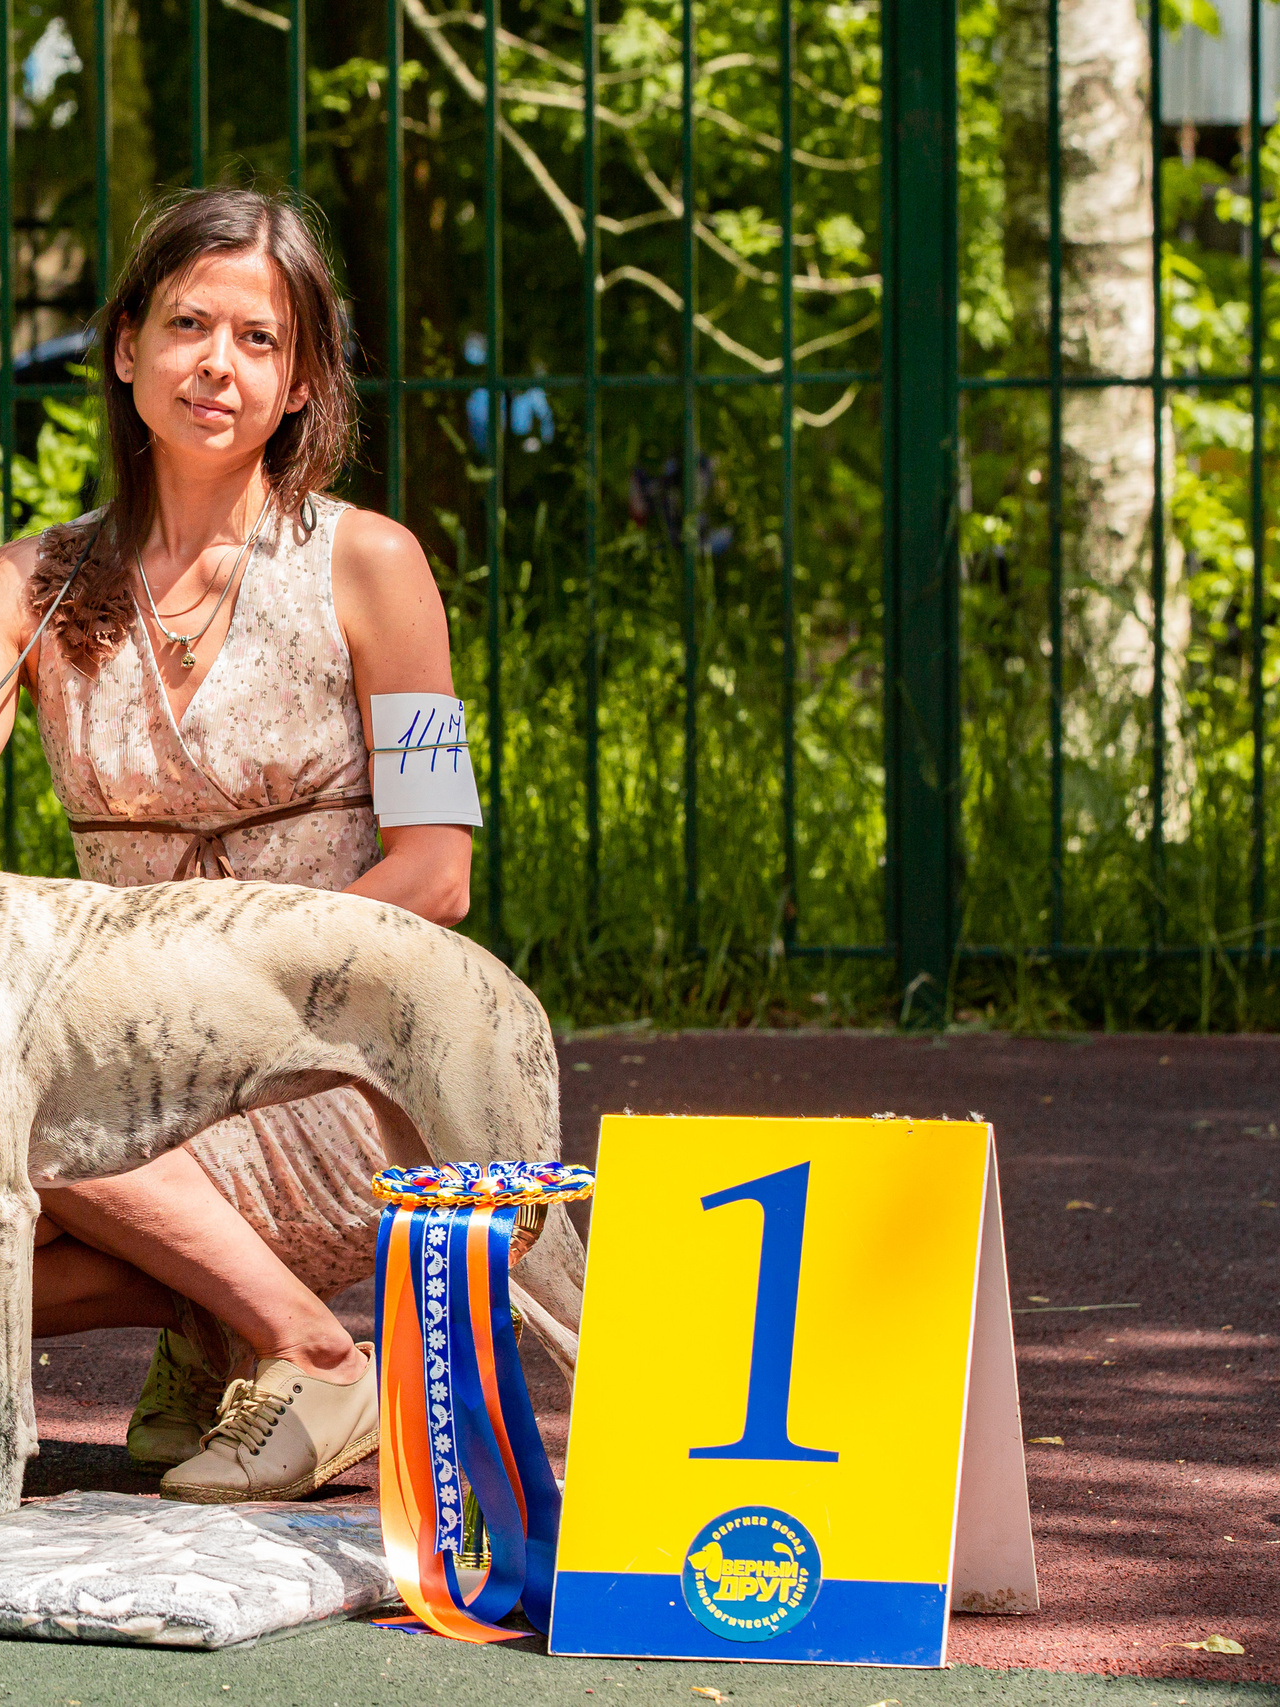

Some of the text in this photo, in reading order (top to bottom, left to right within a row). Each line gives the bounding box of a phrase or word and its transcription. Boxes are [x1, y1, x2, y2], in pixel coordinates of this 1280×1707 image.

[688, 1160, 839, 1463] 1
[712, 1516, 806, 1555] СЕРГИЕВ ПОСАД
[721, 1559, 799, 1578] ВЕРНЫЙ
[695, 1567, 809, 1629] КИНОЛОГИЧЕСКИЙ ЦЕНТР
[712, 1576, 798, 1603] ДРУГ
